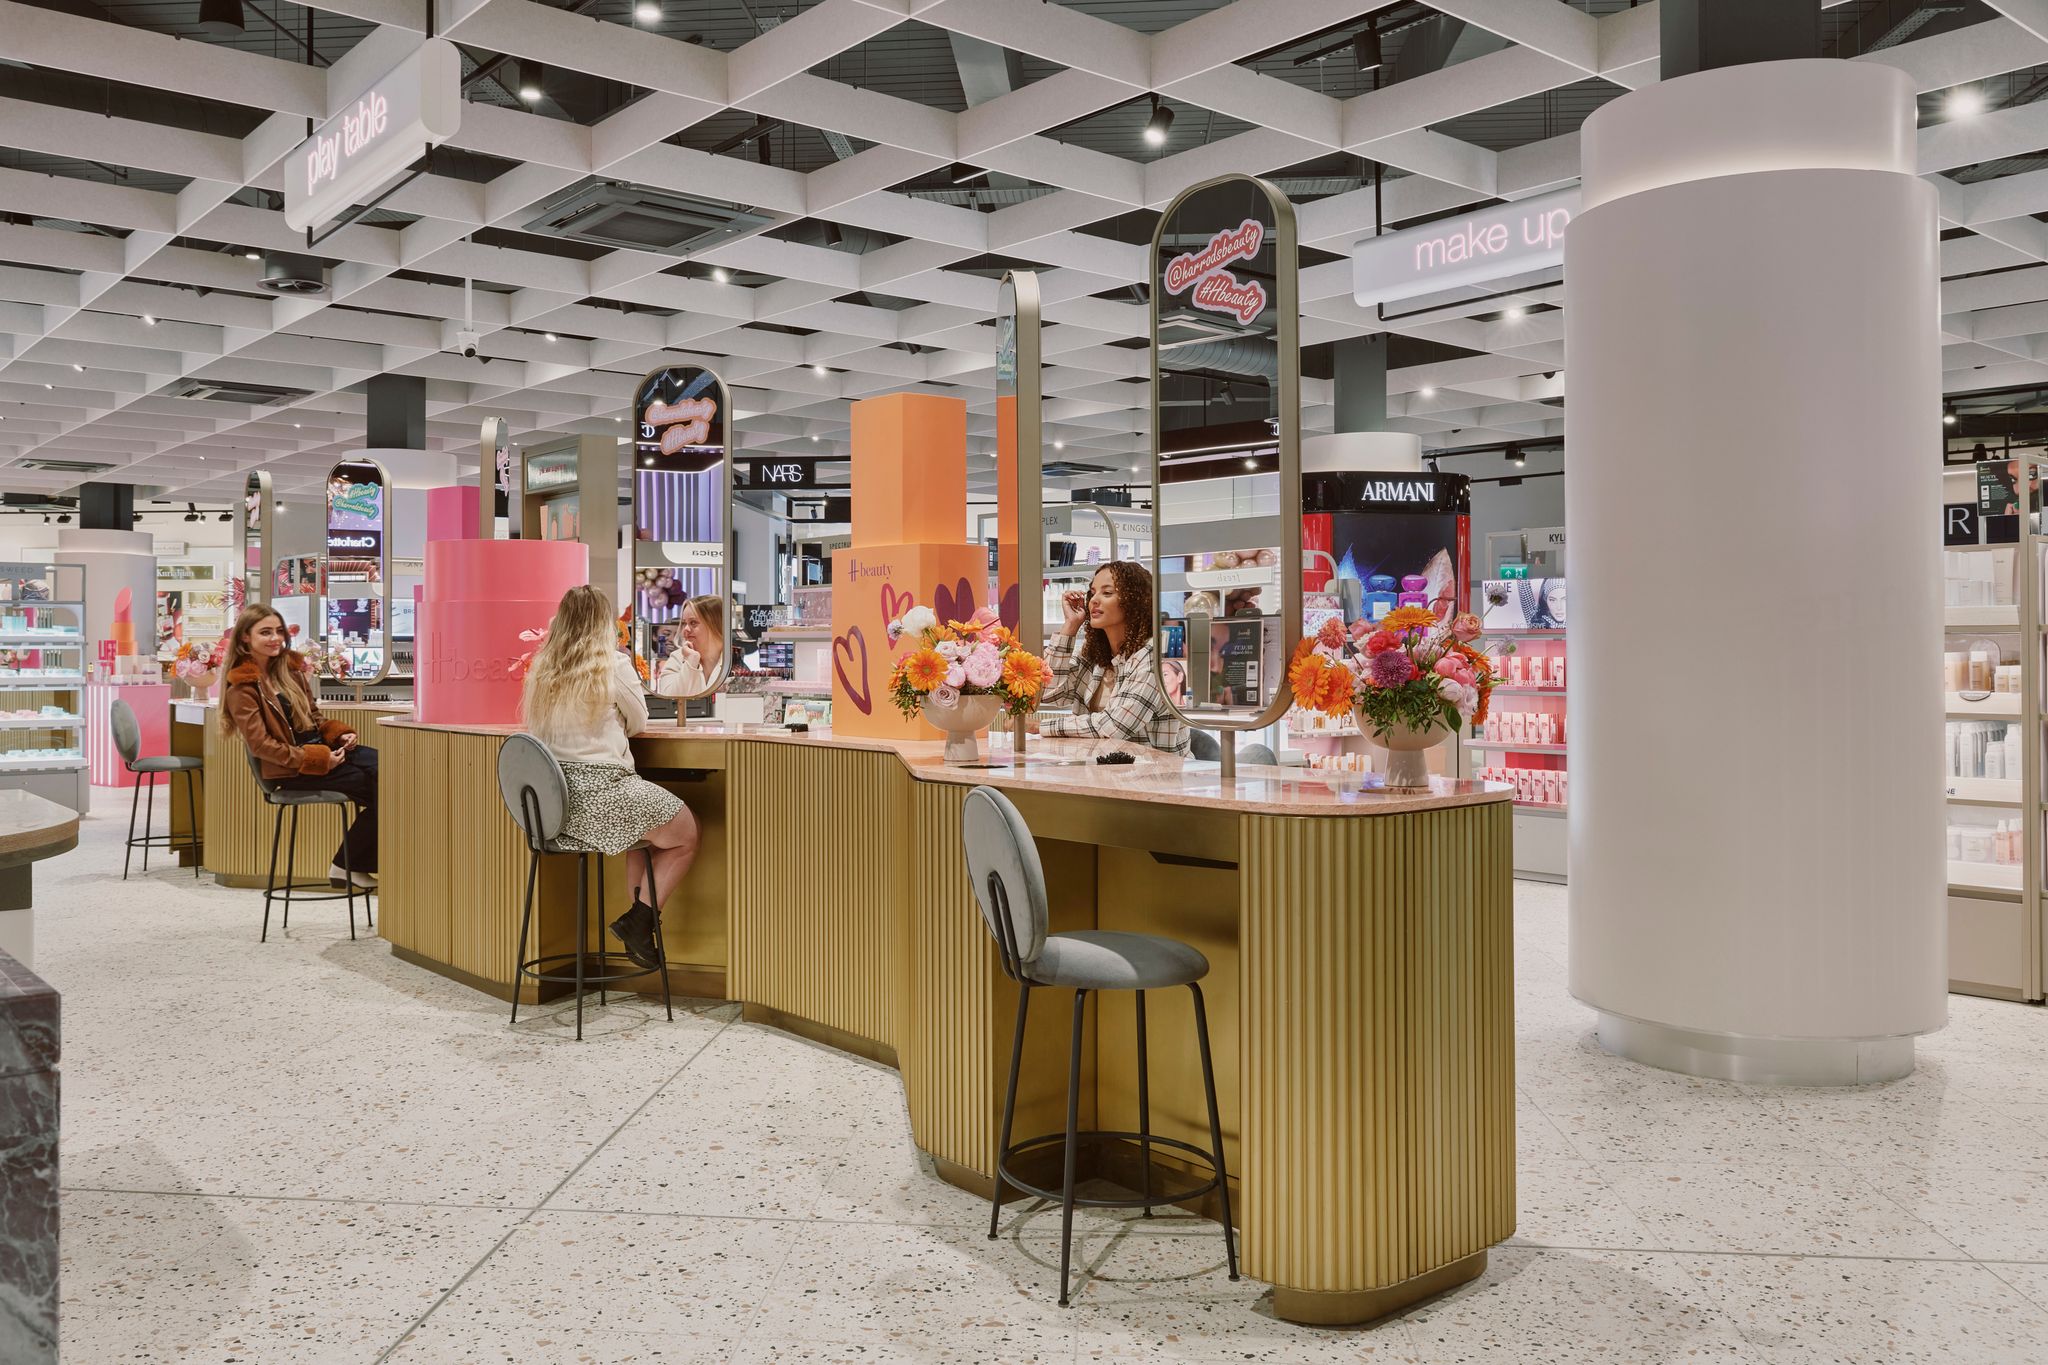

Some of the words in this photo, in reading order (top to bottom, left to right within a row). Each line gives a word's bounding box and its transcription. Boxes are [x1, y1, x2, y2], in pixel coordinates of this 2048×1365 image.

[306, 130, 340, 196] play
[343, 91, 388, 158] table
[1169, 227, 1259, 287] @harrodsbeauty
[1415, 221, 1509, 271] make
[1523, 207, 1571, 249] up
[1199, 278, 1260, 316] #Hbeauty
[762, 464, 802, 482] NARS
[1361, 481, 1435, 502] ARMANI
[860, 562, 893, 580] beauty
